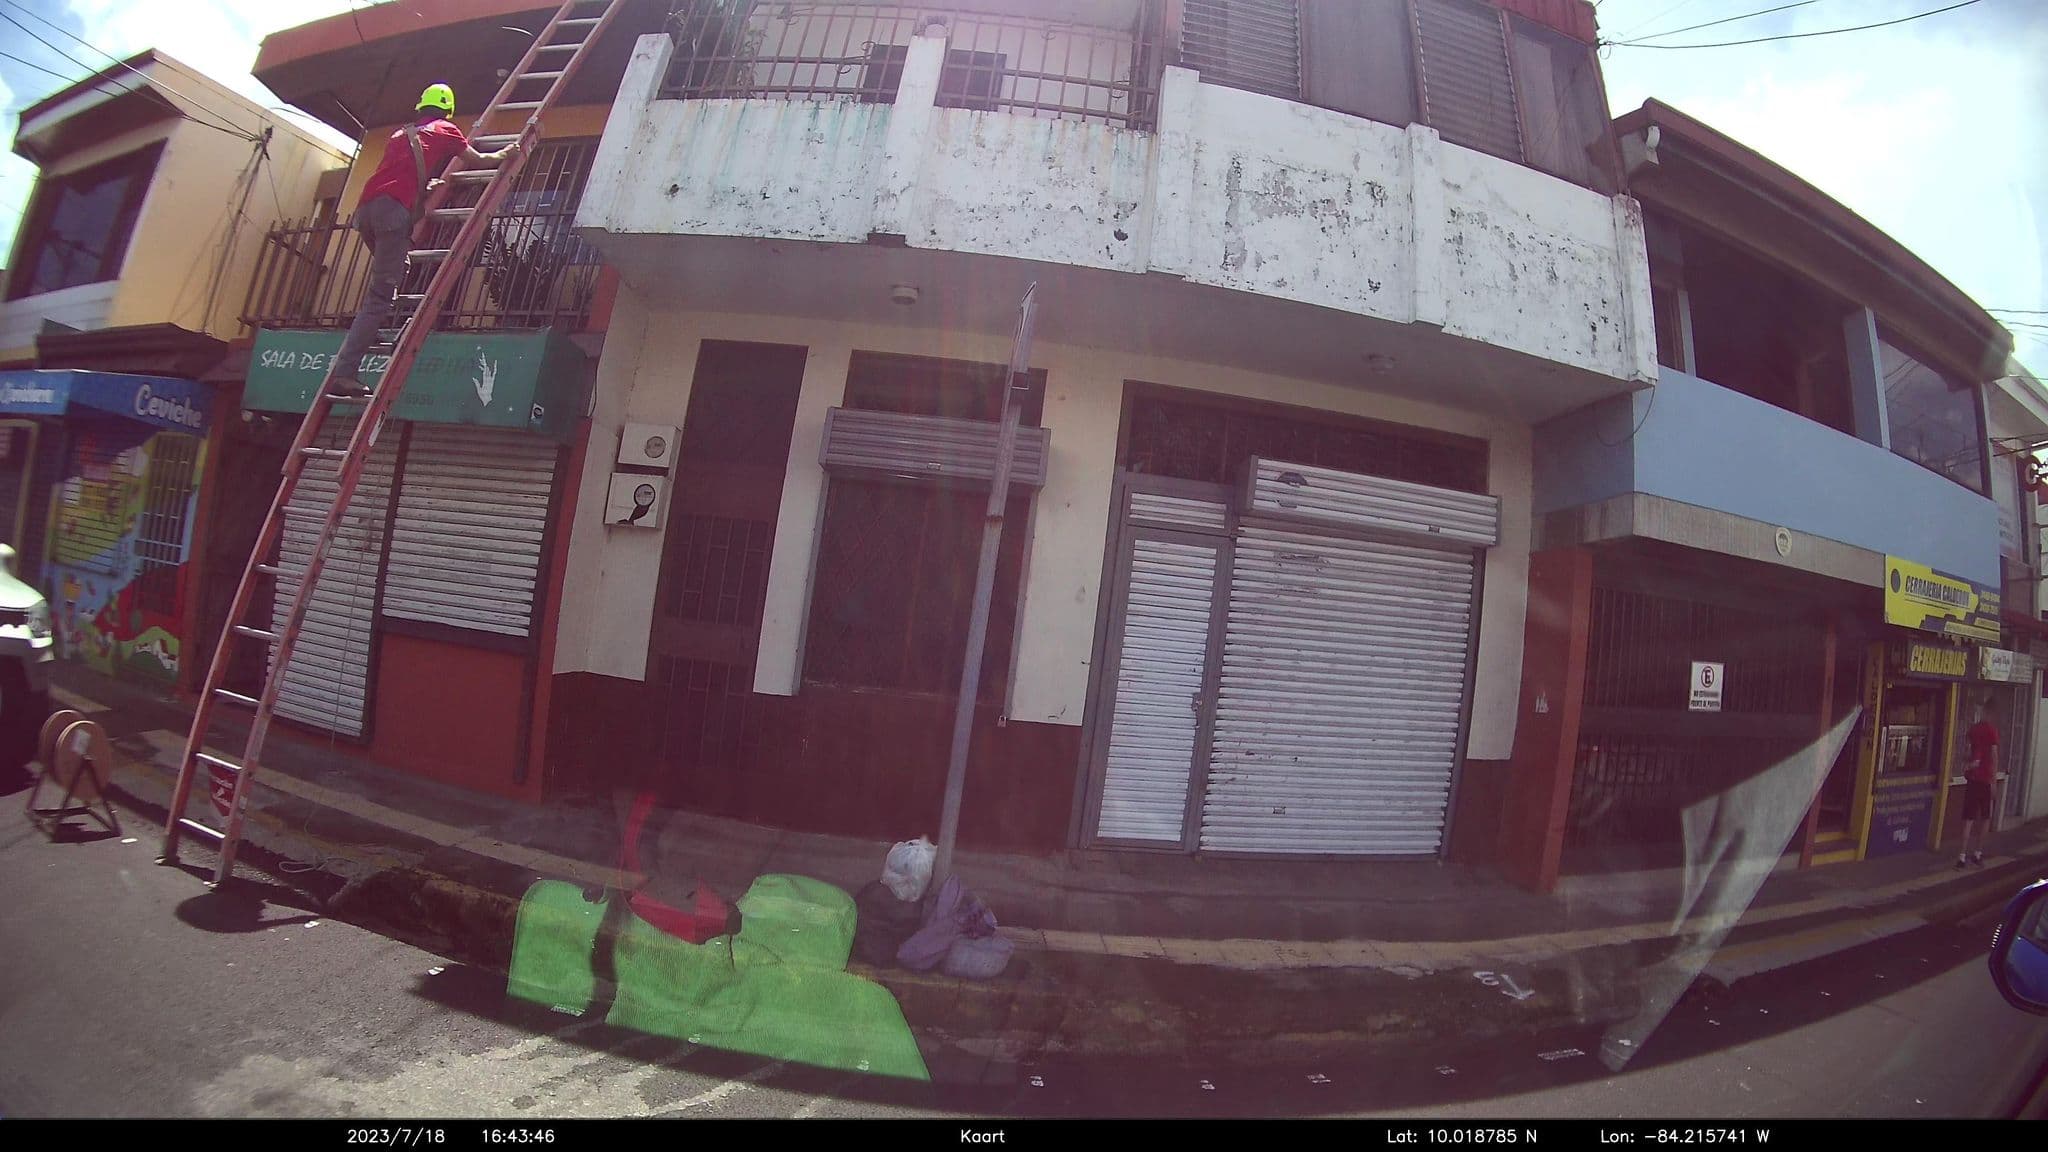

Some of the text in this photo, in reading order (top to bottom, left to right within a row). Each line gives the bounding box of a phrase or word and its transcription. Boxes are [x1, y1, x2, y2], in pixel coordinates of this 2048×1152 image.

[260, 349, 296, 369] SALA
[299, 351, 325, 370] DE
[135, 383, 202, 428] Ceviche
[1905, 575, 1942, 601] CERRAJERIA
